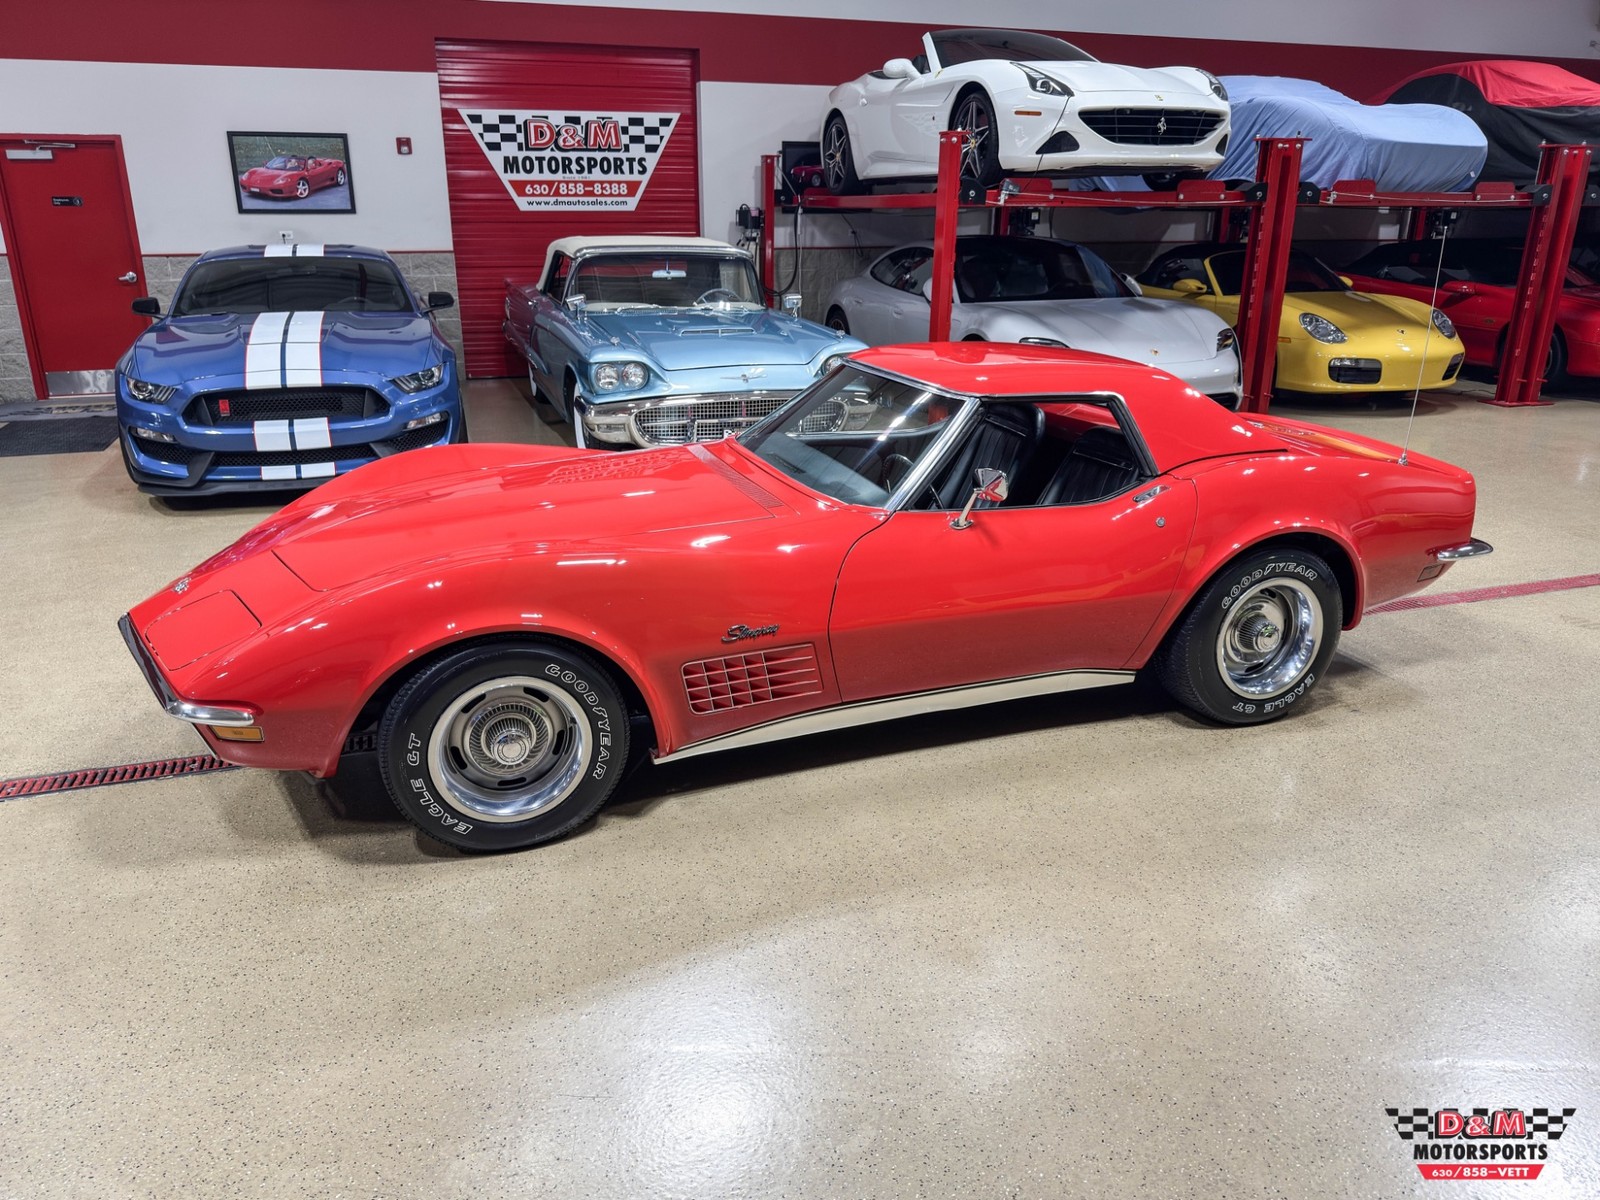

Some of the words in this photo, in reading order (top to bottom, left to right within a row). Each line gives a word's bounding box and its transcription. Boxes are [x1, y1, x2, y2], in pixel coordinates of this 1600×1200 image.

[524, 118, 622, 151] D&M
[503, 156, 648, 175] MOTORSPORTS
[525, 182, 628, 195] 630/858-8388
[526, 199, 628, 207] www.dmautosales.com
[1221, 562, 1318, 609] GOODYEAR
[721, 623, 780, 641] Stingray
[1232, 701, 1256, 713] GT
[1263, 673, 1315, 713] EAGLE
[544, 663, 612, 780] GOODYEAR
[406, 733, 421, 766] GT
[410, 778, 473, 835] EAGLE
